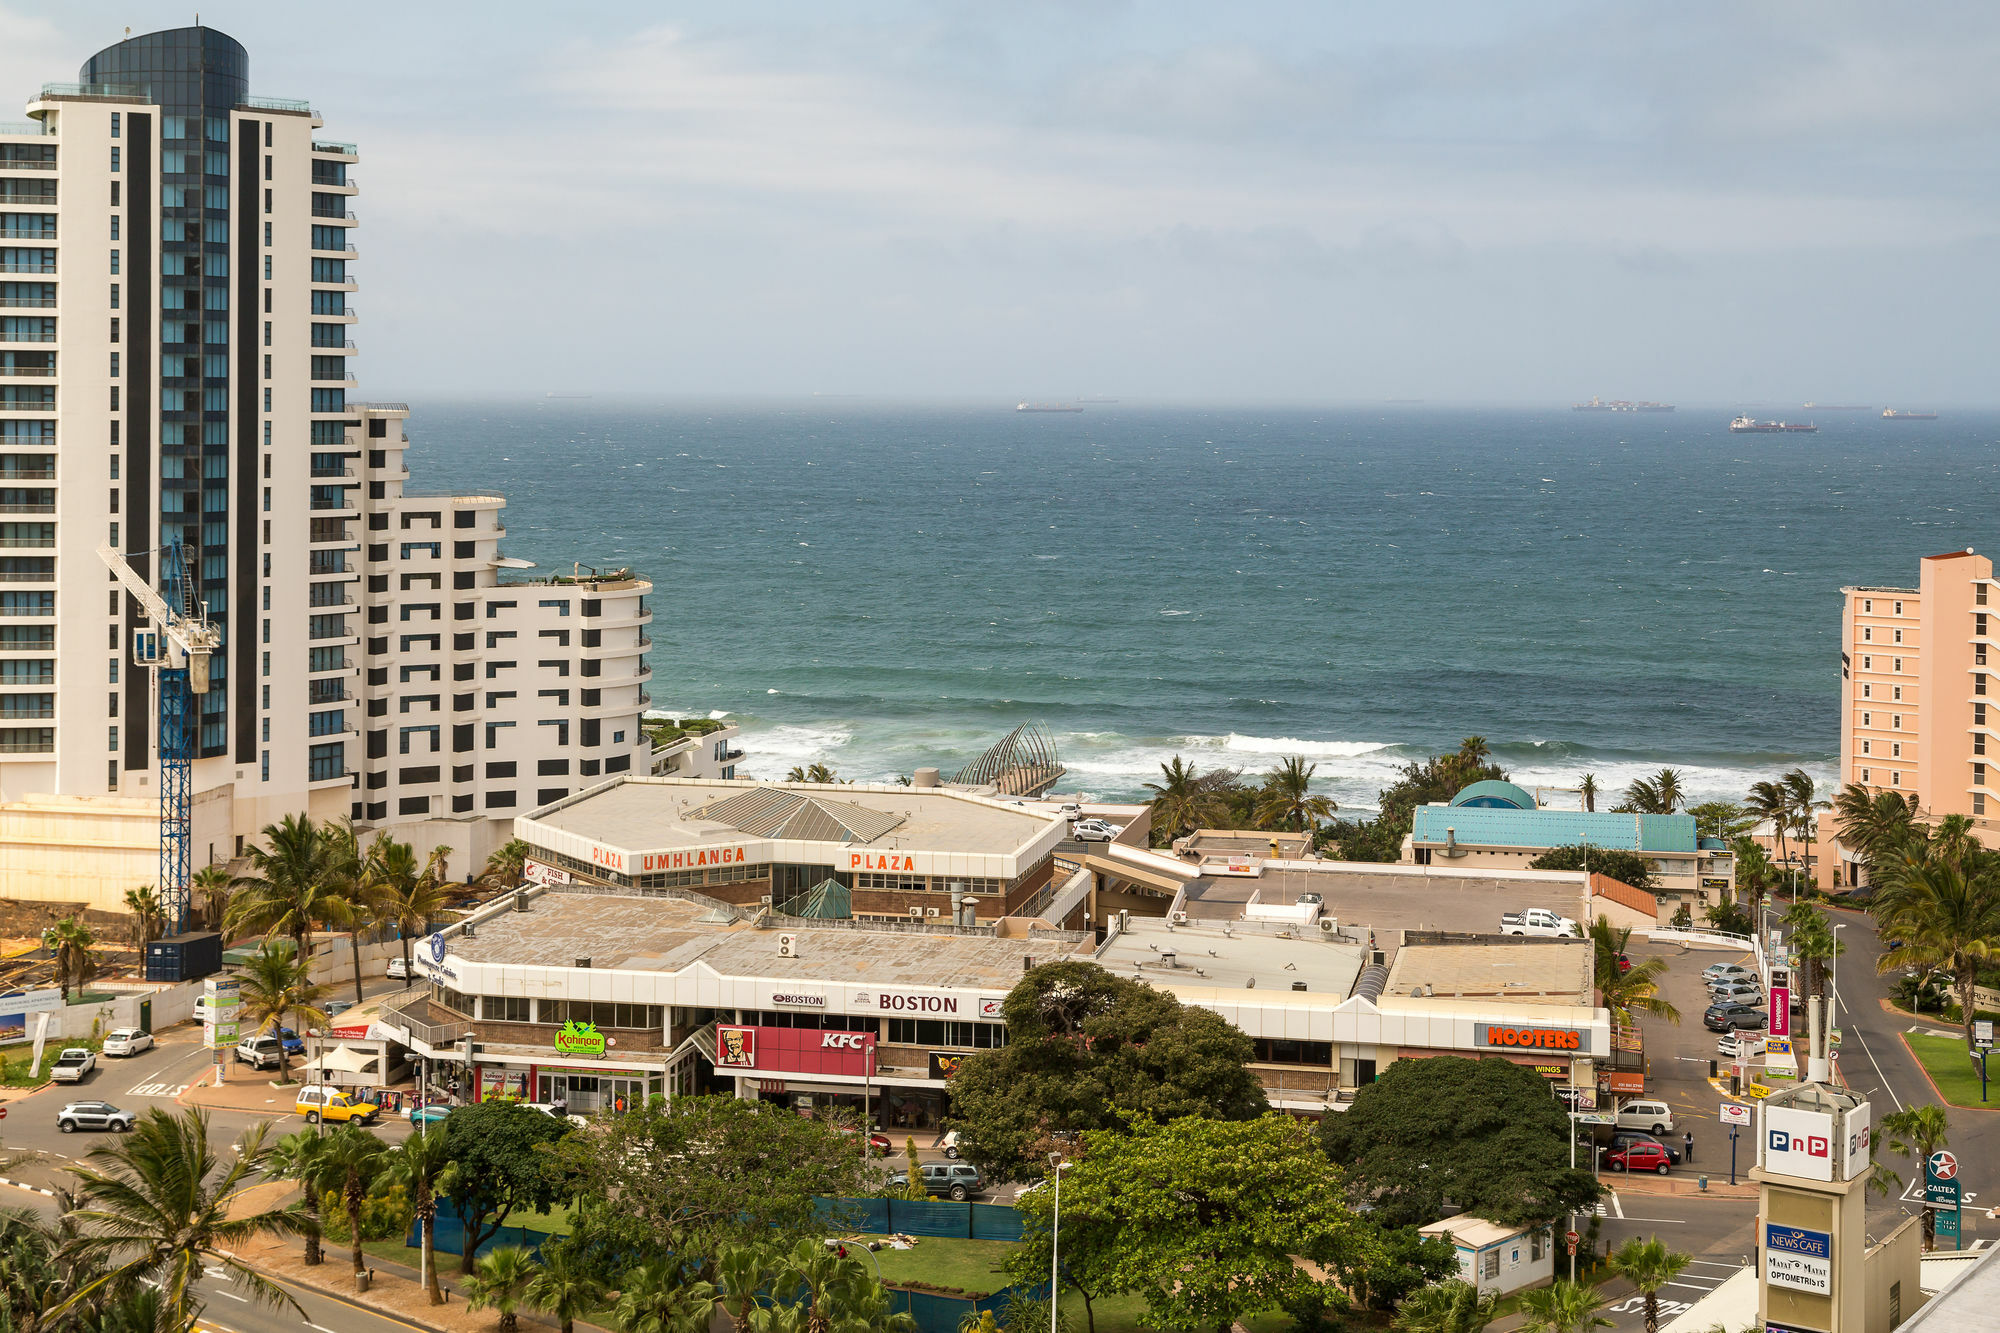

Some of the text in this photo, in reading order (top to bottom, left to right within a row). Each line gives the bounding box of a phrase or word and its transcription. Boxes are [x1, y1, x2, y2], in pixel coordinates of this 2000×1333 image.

[593, 847, 622, 870] PLAZA
[644, 847, 914, 871] UMHLANGA PLAZA
[542, 876, 547, 884] &
[547, 868, 563, 880] FISH
[432, 974, 444, 986] Sushi
[440, 965, 457, 979] Cuisine
[784, 994, 823, 1005] BOSTON
[879, 994, 957, 1013] BOSTON
[558, 1031, 602, 1049] Kohinoor
[821, 1033, 866, 1049] KFC
[1488, 1026, 1580, 1049] HOOTERS
[1535, 1065, 1561, 1073] WINGS
[132, 1083, 190, 1096] STOP
[1771, 1128, 1868, 1156] PnP PnP
[1928, 1185, 1955, 1194] CALTEX
[1772, 1236, 1823, 1253] NEWS CAFE
[1769, 1257, 1827, 1277] MAYAT MAYAT
[1771, 1271, 1825, 1288] OPTOMETRISTS
